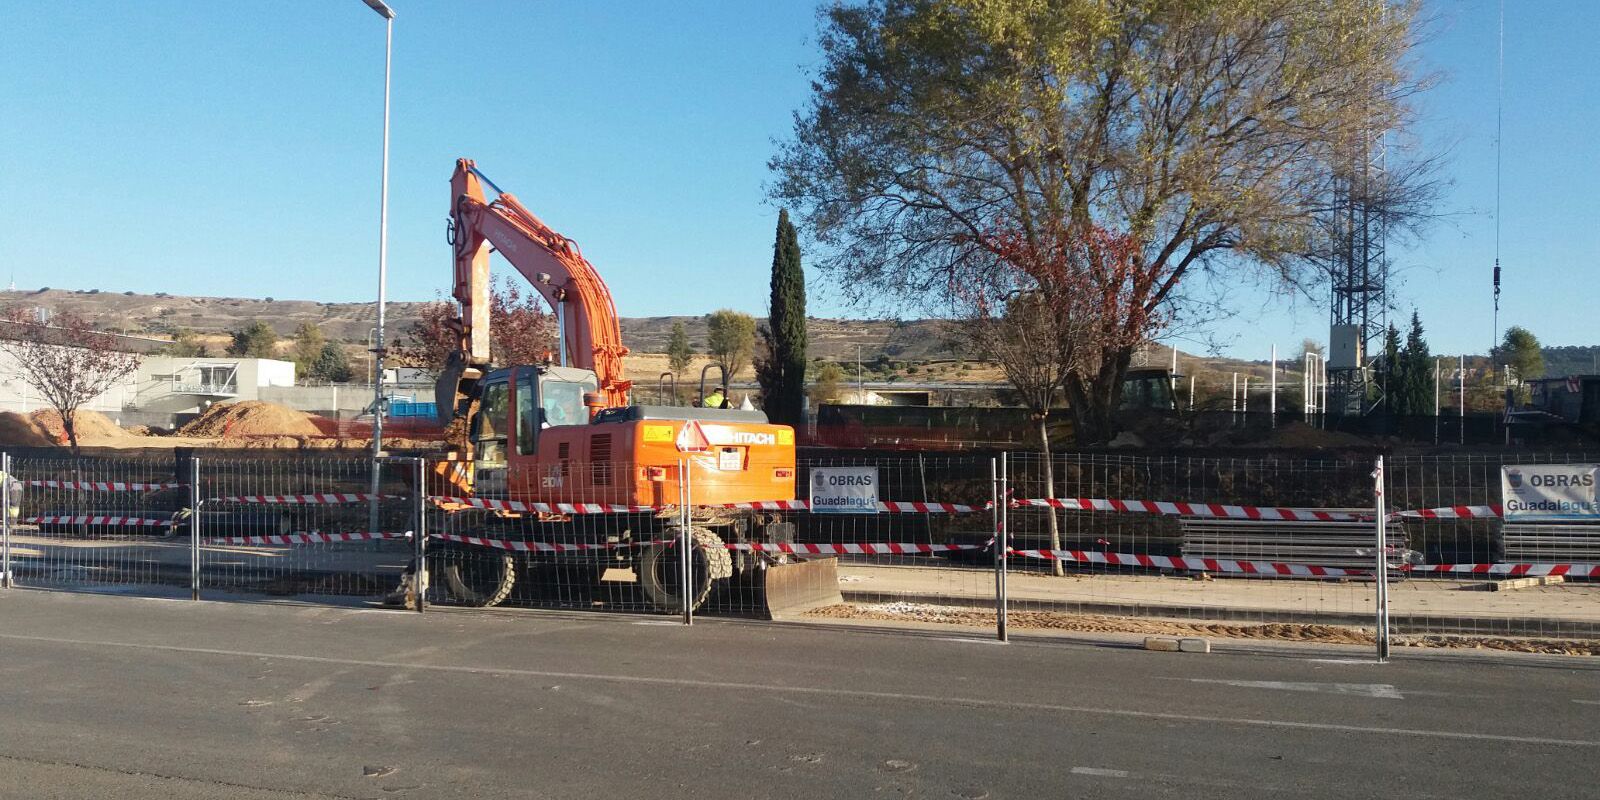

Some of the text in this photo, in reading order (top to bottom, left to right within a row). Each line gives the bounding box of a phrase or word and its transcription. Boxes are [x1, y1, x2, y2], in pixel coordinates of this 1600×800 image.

[731, 431, 775, 445] HITACHI
[829, 475, 872, 486] OBRAS
[1530, 474, 1594, 487] OBRAS
